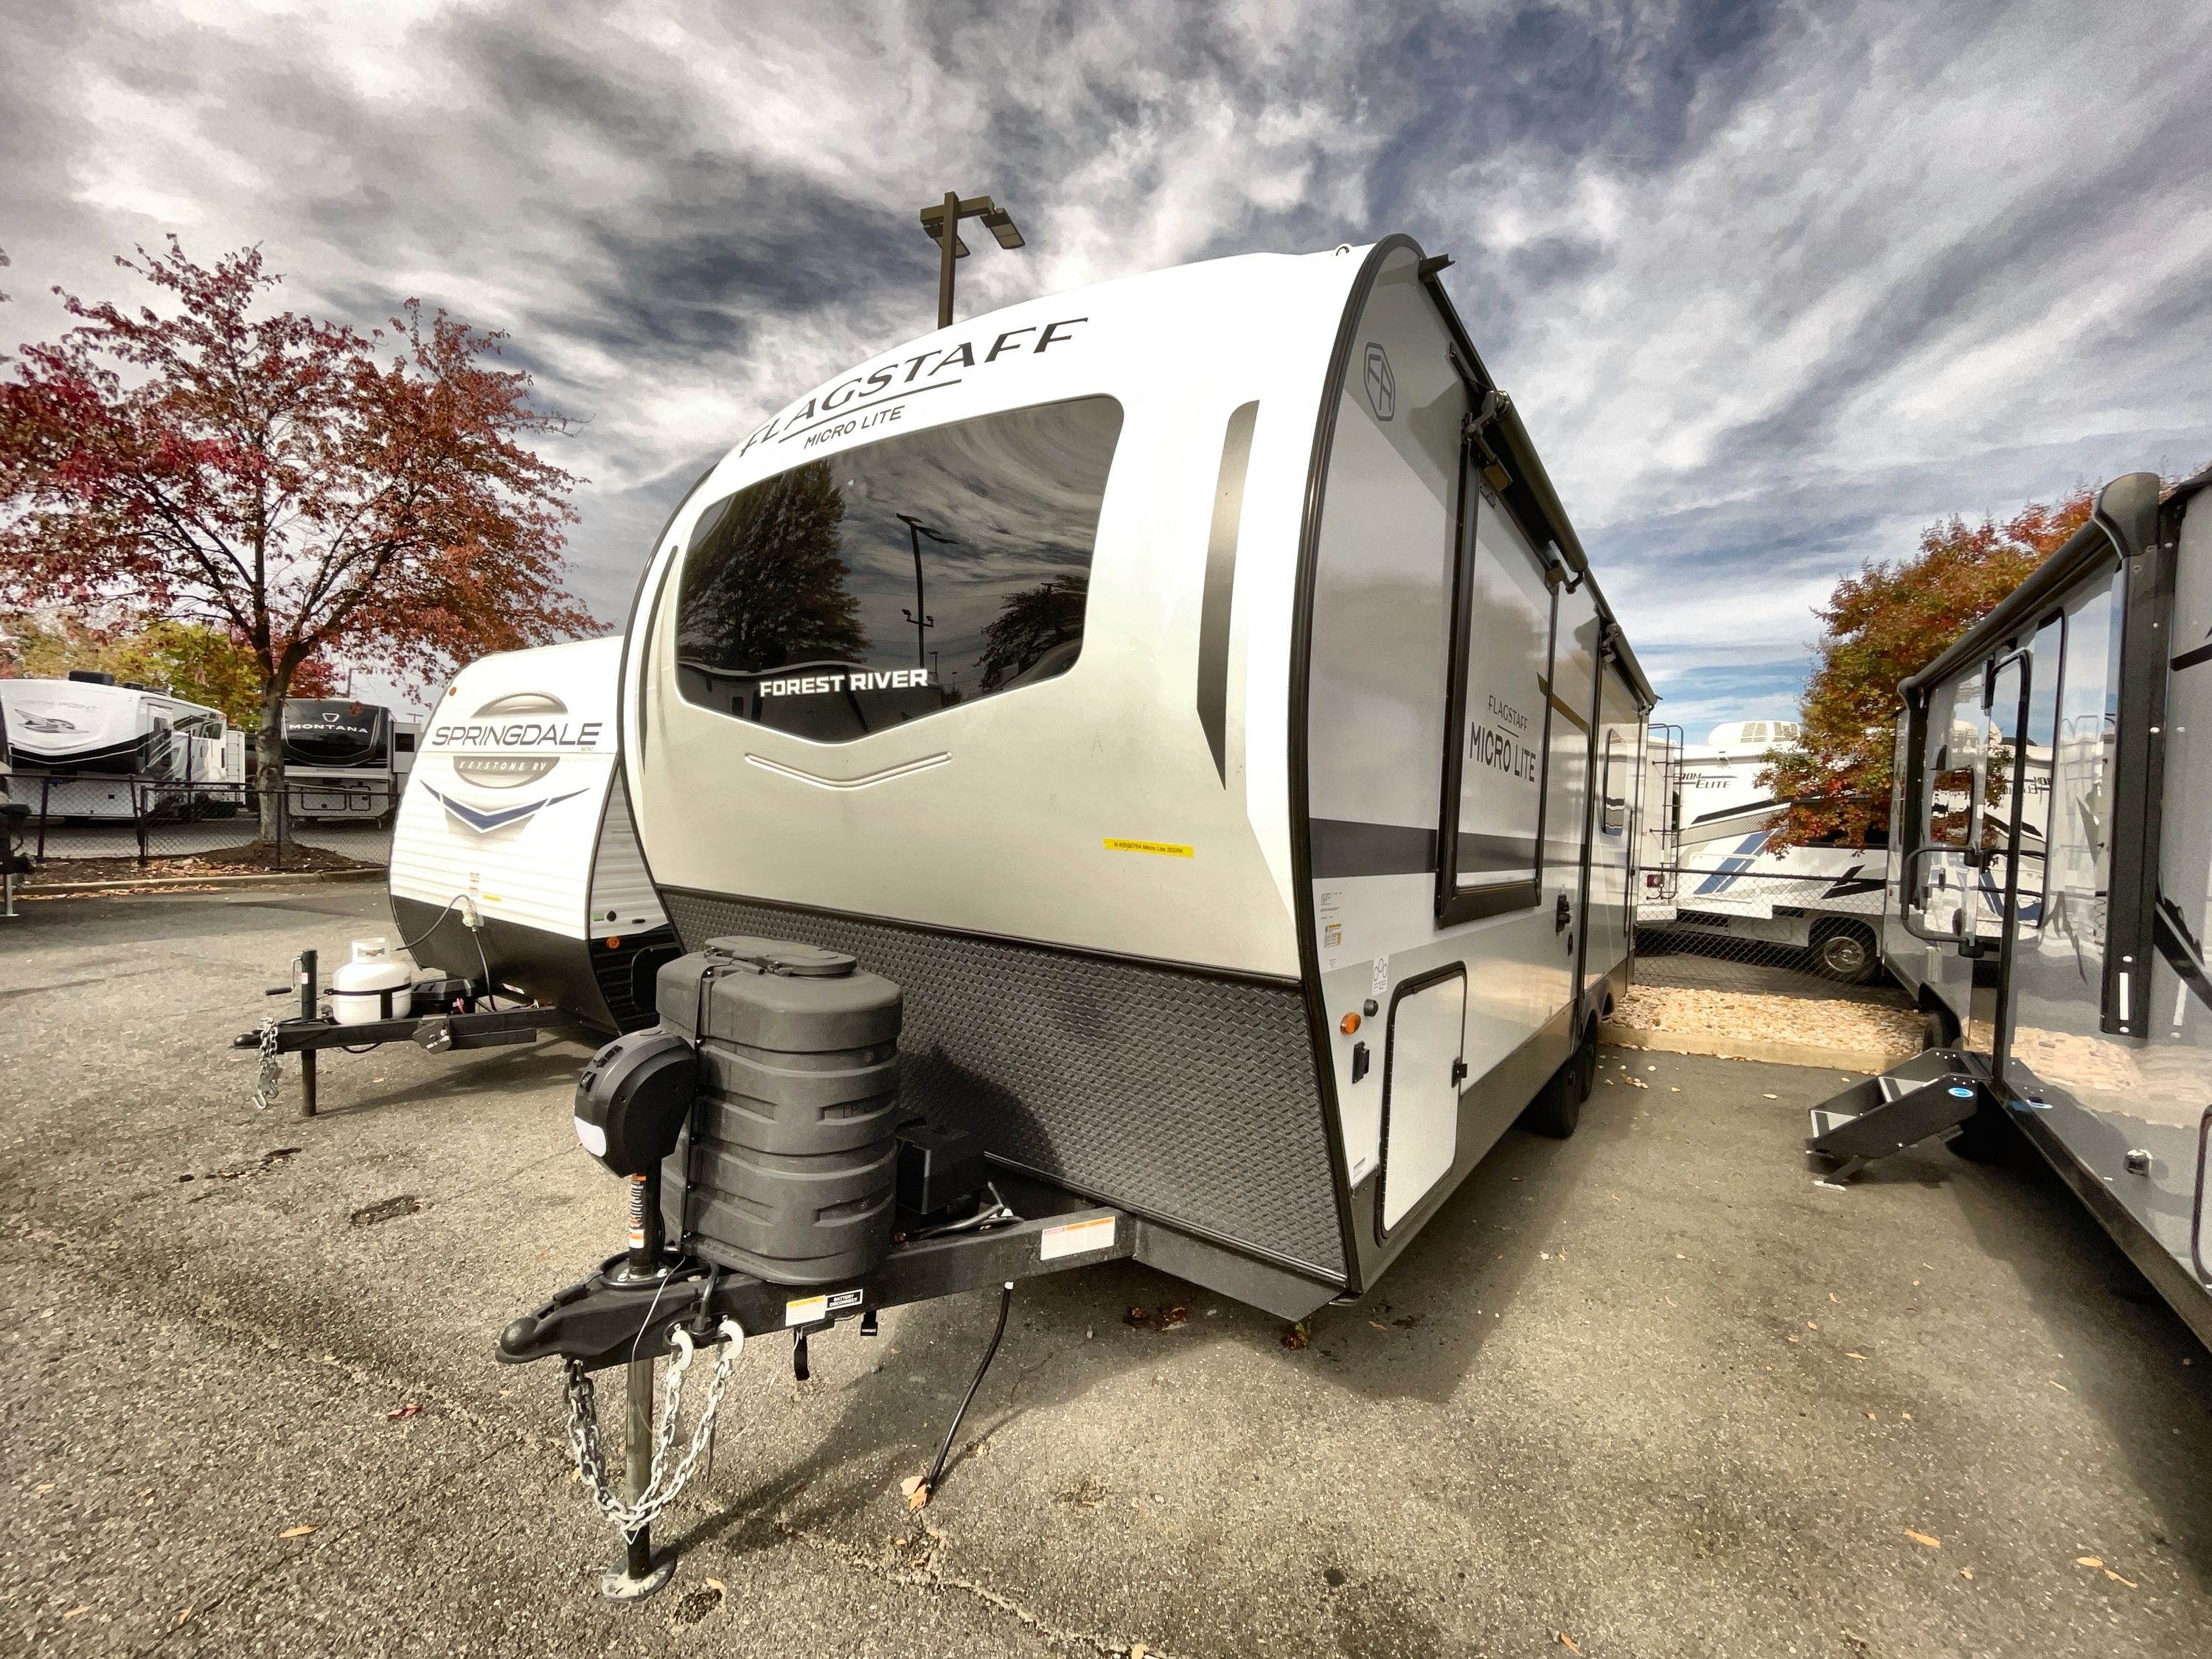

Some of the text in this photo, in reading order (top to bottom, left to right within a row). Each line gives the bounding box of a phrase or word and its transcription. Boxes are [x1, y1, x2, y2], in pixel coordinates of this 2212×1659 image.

[739, 317, 1088, 457] FLAGSTAFF
[804, 405, 905, 449] MICRO LITE
[759, 669, 928, 698] FOREST RIVER
[1488, 695, 1528, 731] FLAGSTAFF
[288, 723, 369, 734] MONTANA
[432, 723, 602, 745] SPRINGDALE
[1470, 721, 1537, 782] MICRO LITE
[459, 761, 547, 771] KEYSTONE RV
[829, 1297, 858, 1307] DISCONNECT
[833, 1293, 855, 1302] BATTERY
